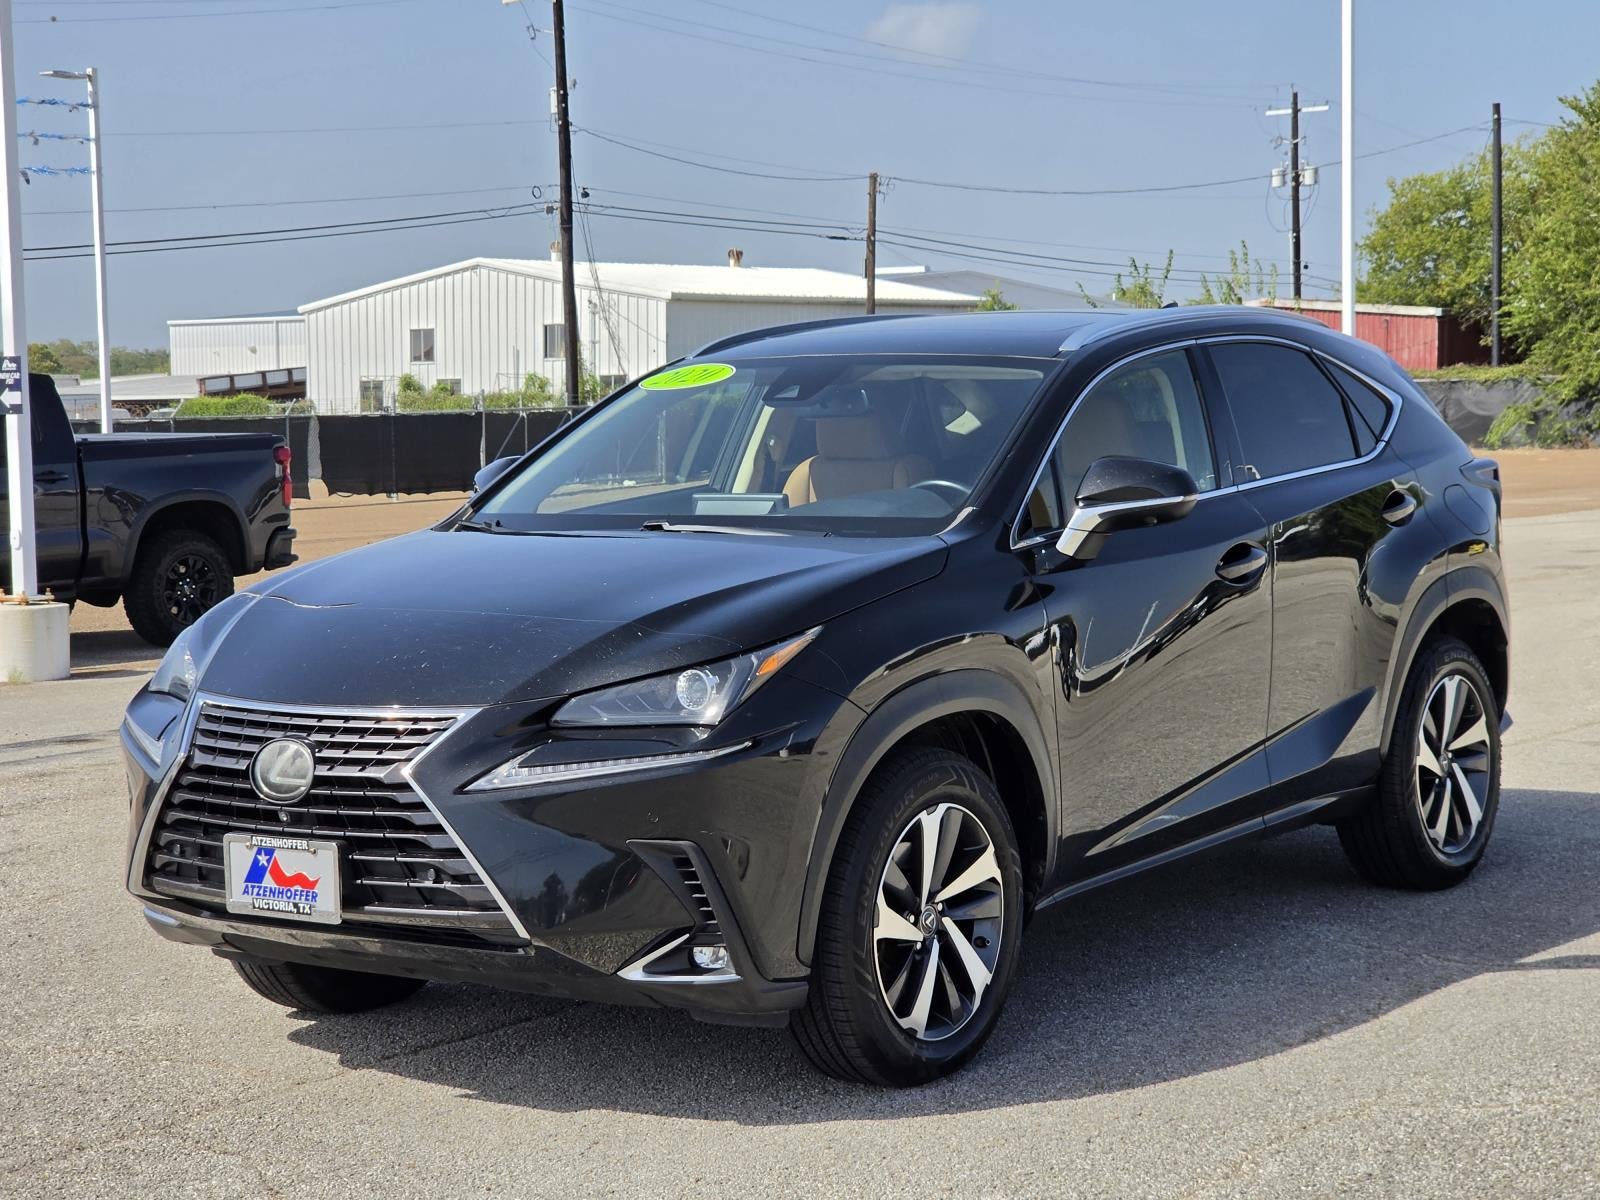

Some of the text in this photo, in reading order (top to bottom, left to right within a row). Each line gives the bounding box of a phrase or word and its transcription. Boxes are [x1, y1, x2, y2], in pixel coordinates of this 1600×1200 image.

[252, 836, 308, 850] ATZENHOFFER
[242, 884, 319, 902] ATZENHOFFER
[253, 898, 311, 914] VICTORIA, TX
